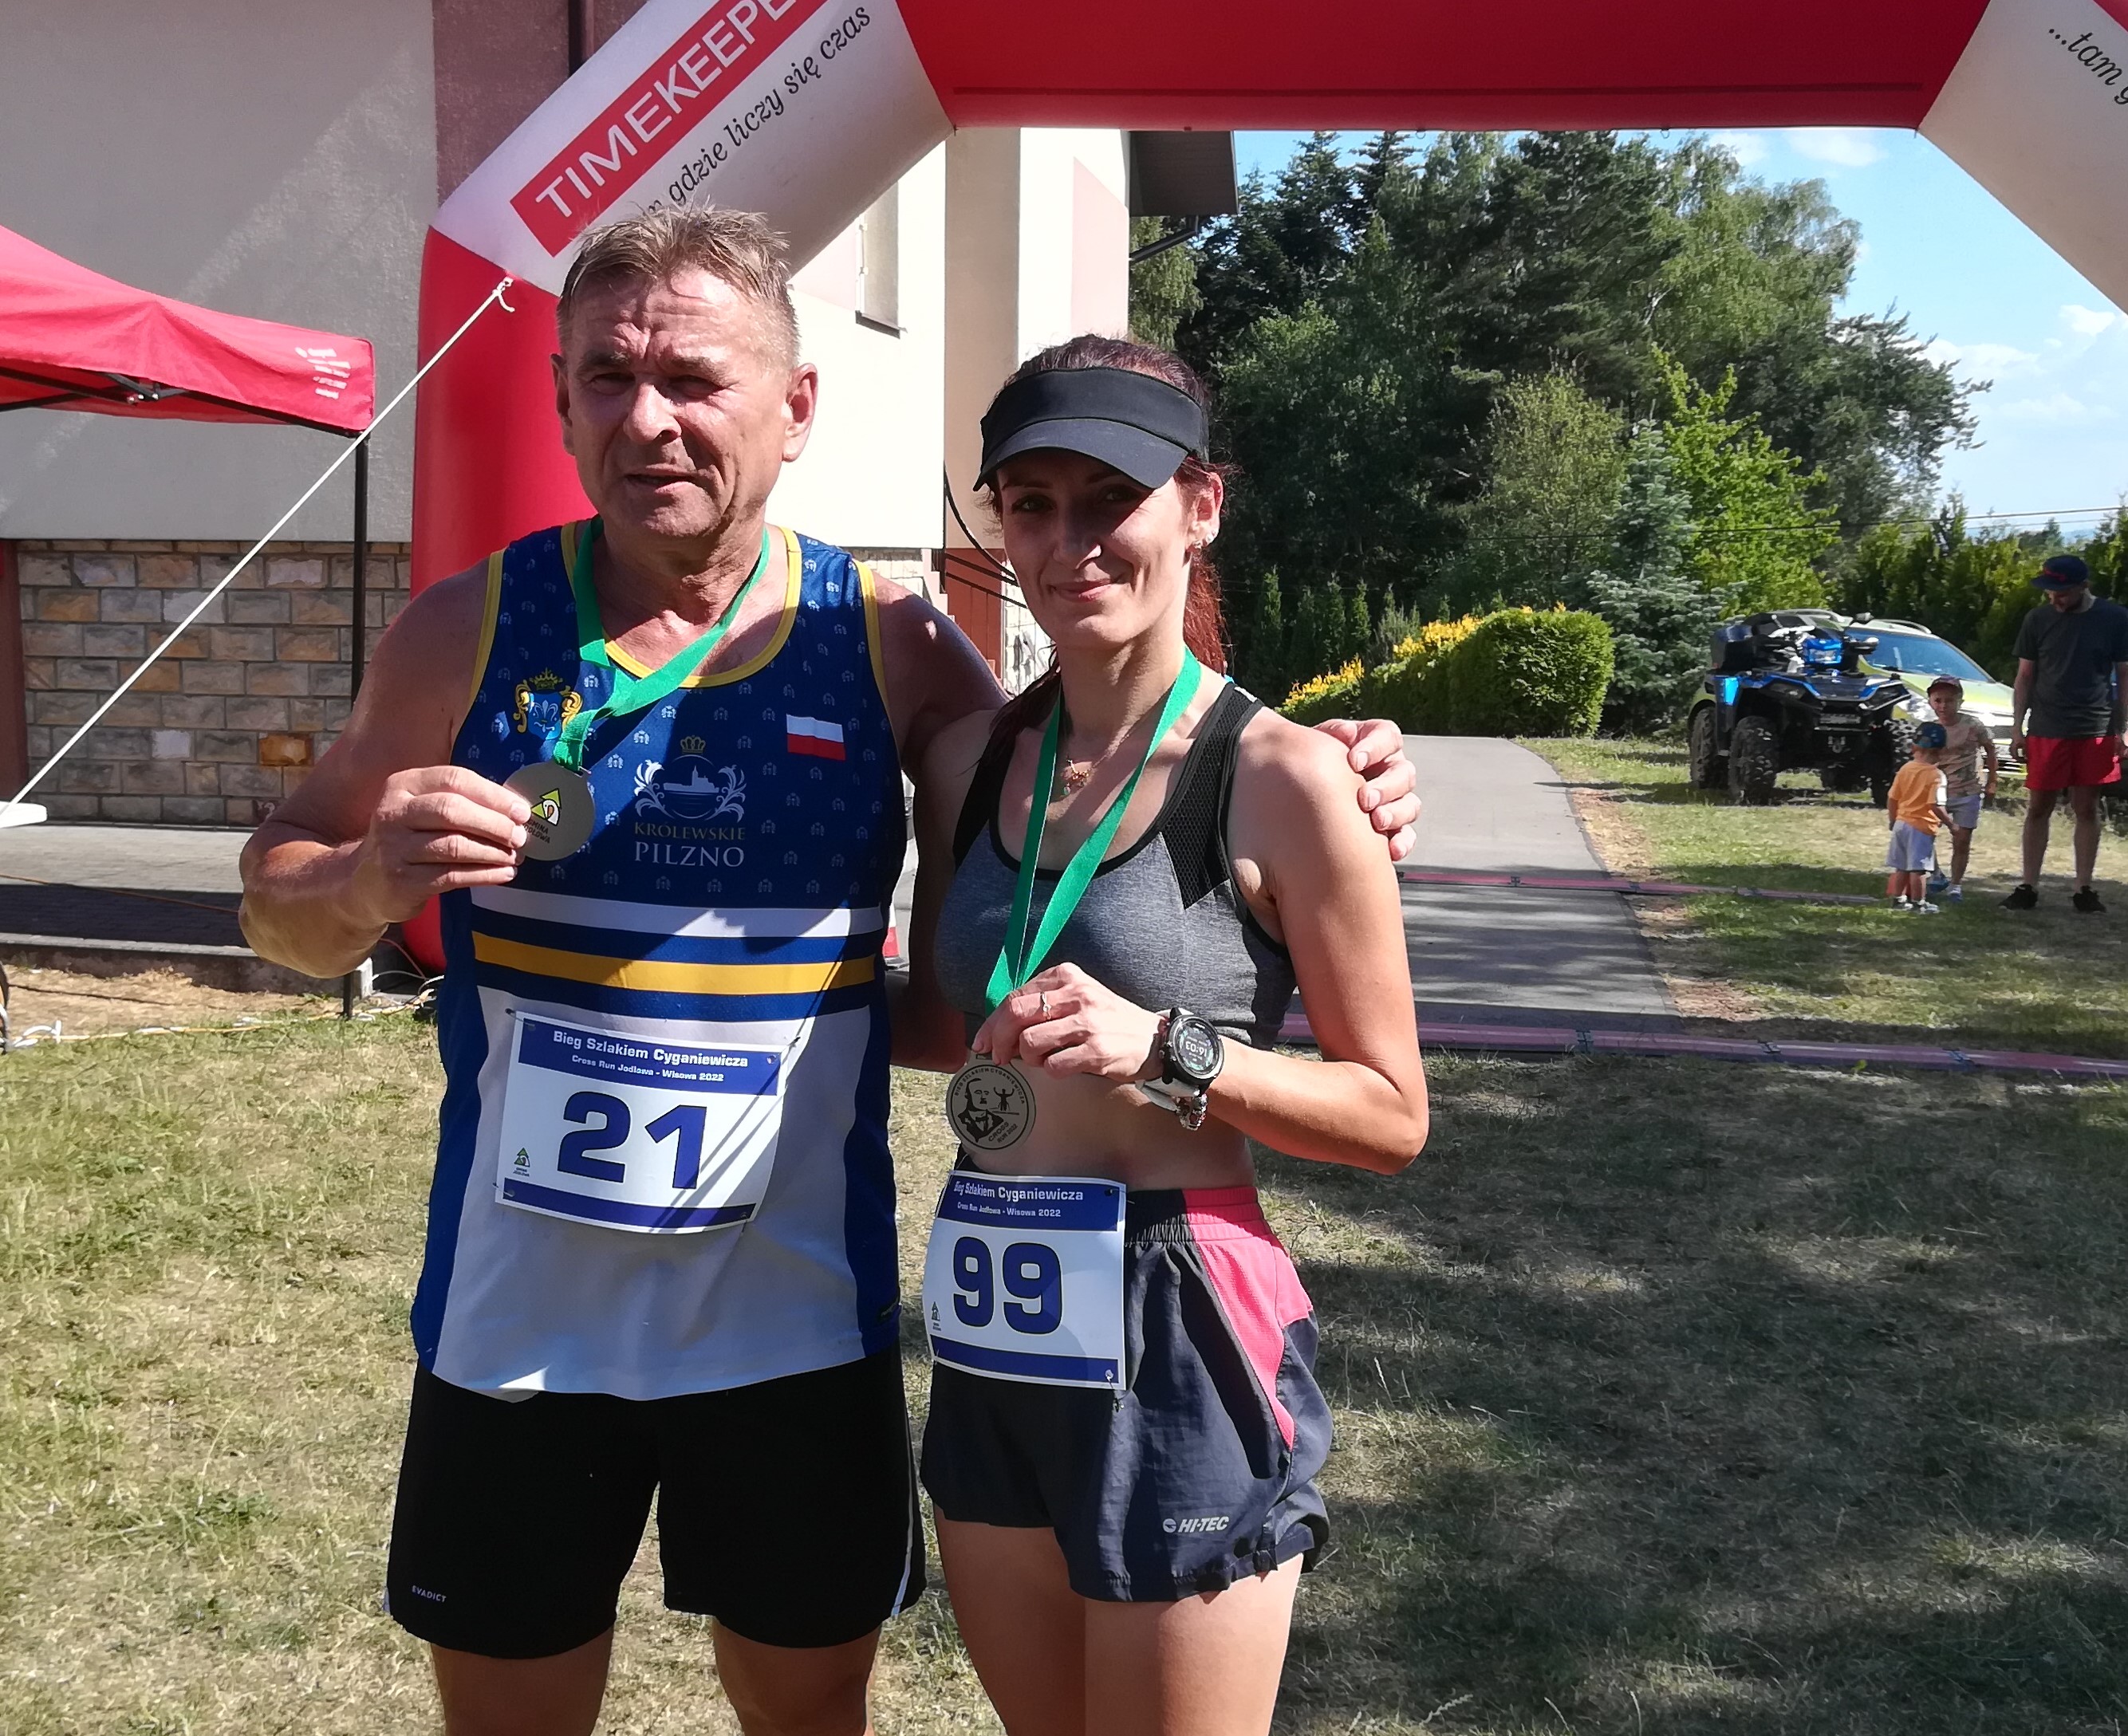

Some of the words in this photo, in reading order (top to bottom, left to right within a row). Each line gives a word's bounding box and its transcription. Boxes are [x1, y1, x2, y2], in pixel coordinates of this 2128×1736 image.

[668, 142, 728, 207] gdzie
[723, 89, 784, 147] liczy
[784, 57, 822, 95] się
[820, 6, 871, 60] czas
[634, 821, 746, 840] KRÓLEWSKIE
[634, 840, 745, 868] PILZNO
[553, 1030, 582, 1050] Bieg
[586, 1037, 649, 1060] Szlakiem
[653, 1049, 748, 1068] Cyganiewicza
[572, 1054, 597, 1067] Cross
[598, 1060, 616, 1070] Run
[699, 1072, 724, 1082] 2022
[557, 1091, 707, 1190] 21
[998, 1186, 1084, 1203] Cyganiewicza
[1038, 1208, 1062, 1218] 2022
[953, 1236, 1062, 1335] 99
[412, 1584, 447, 1603] EVADICT
